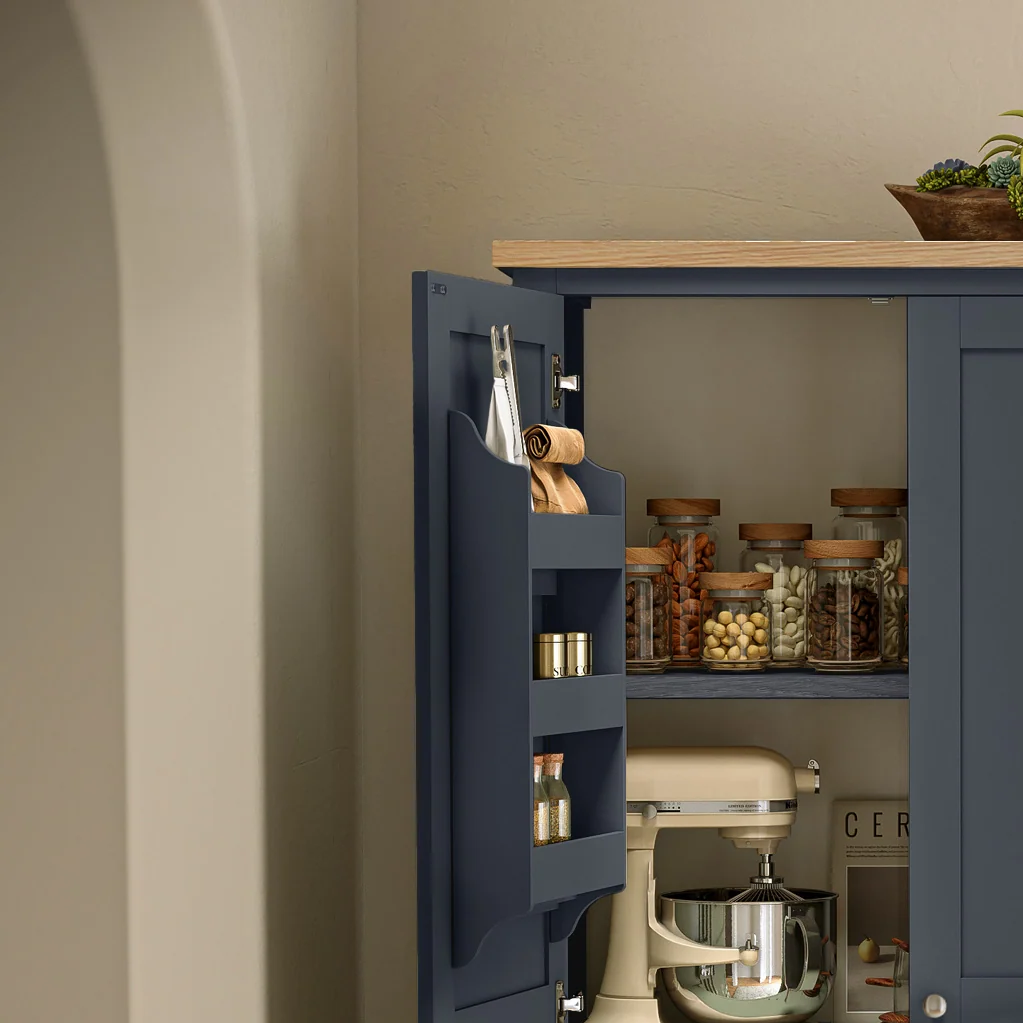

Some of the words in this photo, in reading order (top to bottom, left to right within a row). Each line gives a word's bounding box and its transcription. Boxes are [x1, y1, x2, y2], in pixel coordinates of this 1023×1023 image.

[553, 666, 569, 677] SU
[575, 665, 592, 675] CO
[845, 811, 910, 838] CER
